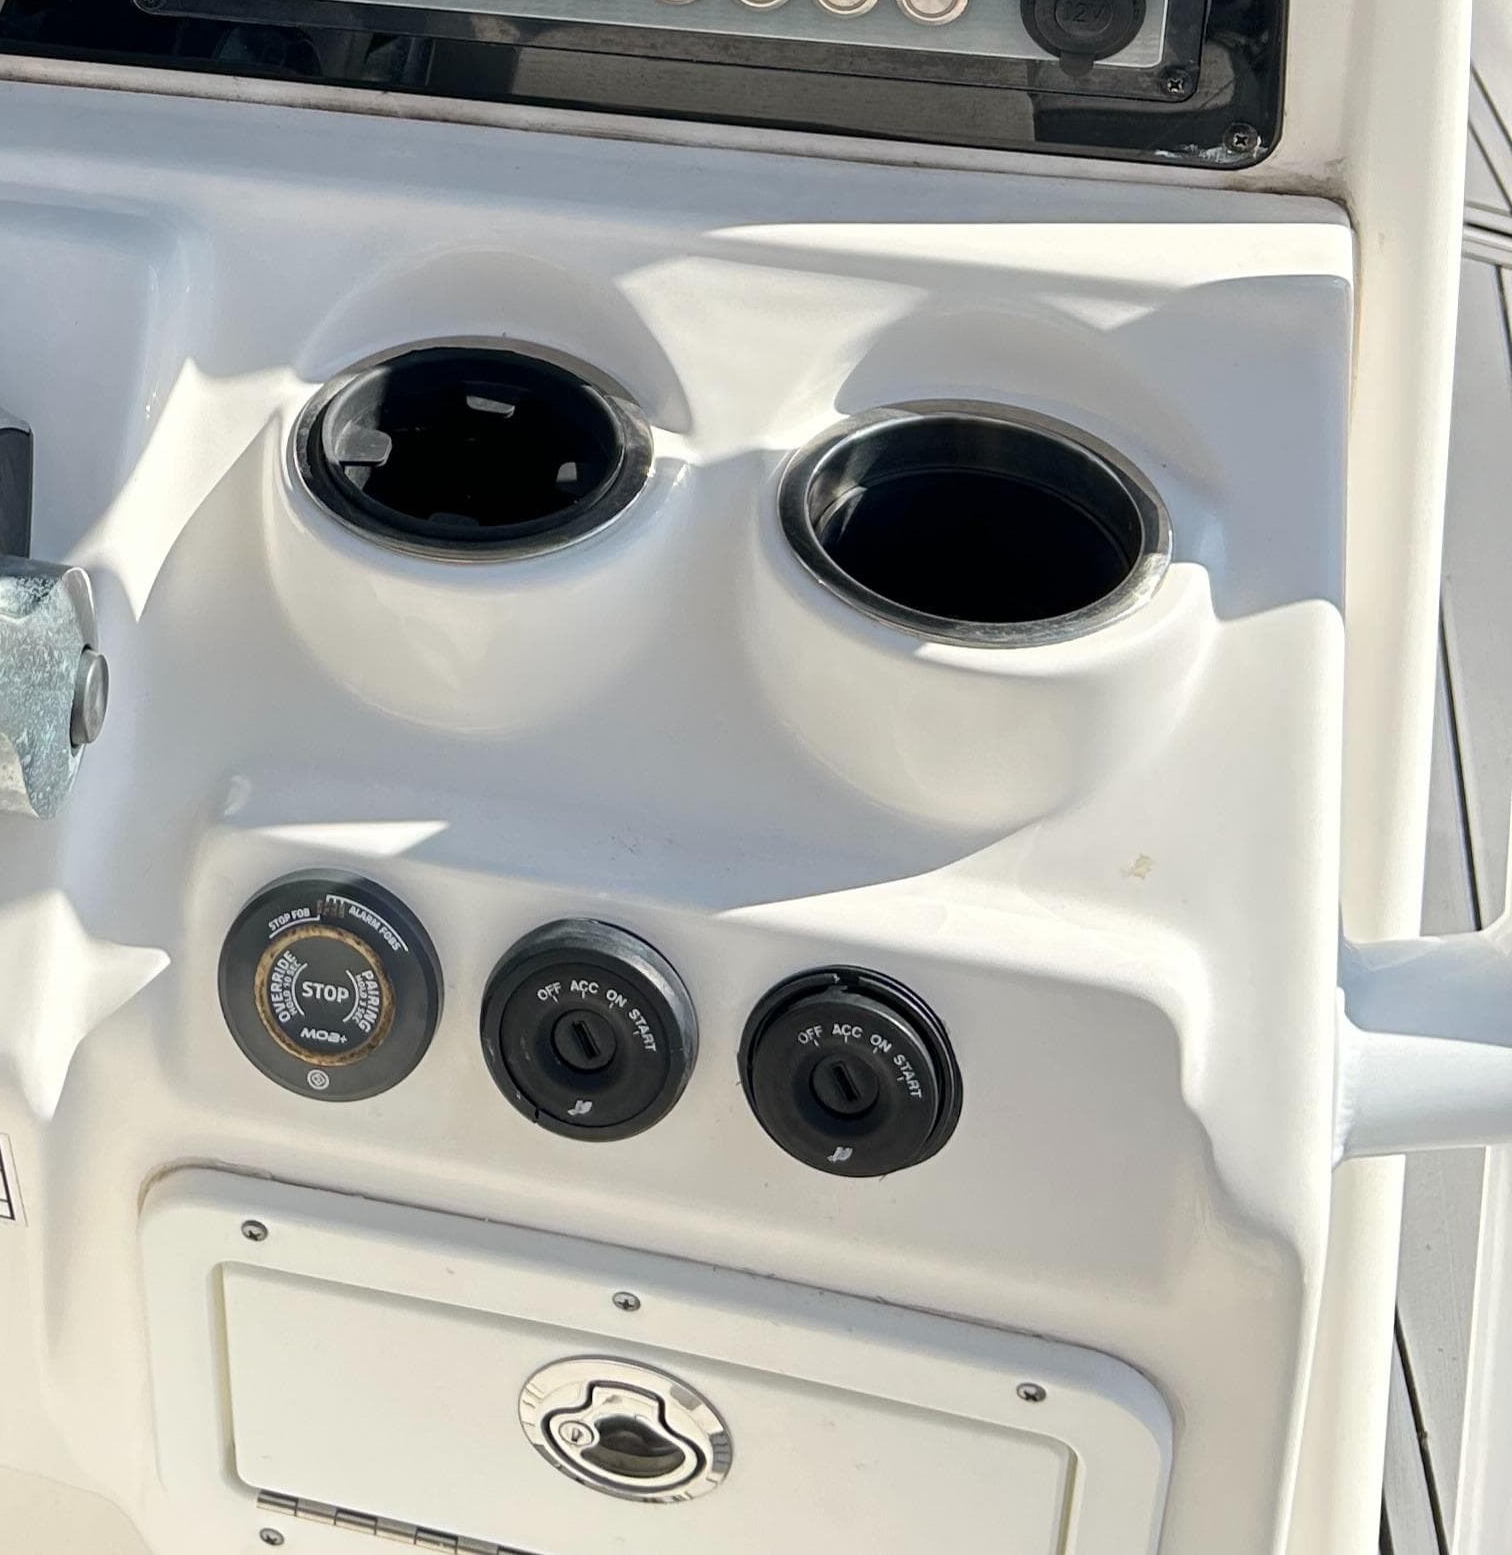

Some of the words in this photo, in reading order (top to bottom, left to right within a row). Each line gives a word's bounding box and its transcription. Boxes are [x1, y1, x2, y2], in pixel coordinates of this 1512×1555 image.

[268, 913, 291, 931] STOP
[291, 908, 310, 920] FOB
[348, 906, 381, 931] ALARM
[379, 927, 401, 951] FOBS
[270, 950, 296, 1023] OVERRIDE
[287, 960, 301, 976] SEC
[283, 990, 297, 1016] HOLD
[302, 981, 349, 1003] STOP
[358, 970, 380, 1033] PAIRING
[537, 982, 562, 1001] OFF
[570, 979, 599, 994] ACC
[606, 989, 627, 1008] ON
[628, 1009, 656, 1052] START
[798, 1025, 824, 1044] OFF
[832, 1023, 863, 1038] ACC
[870, 1034, 892, 1053] ON
[893, 1054, 922, 1098] START
